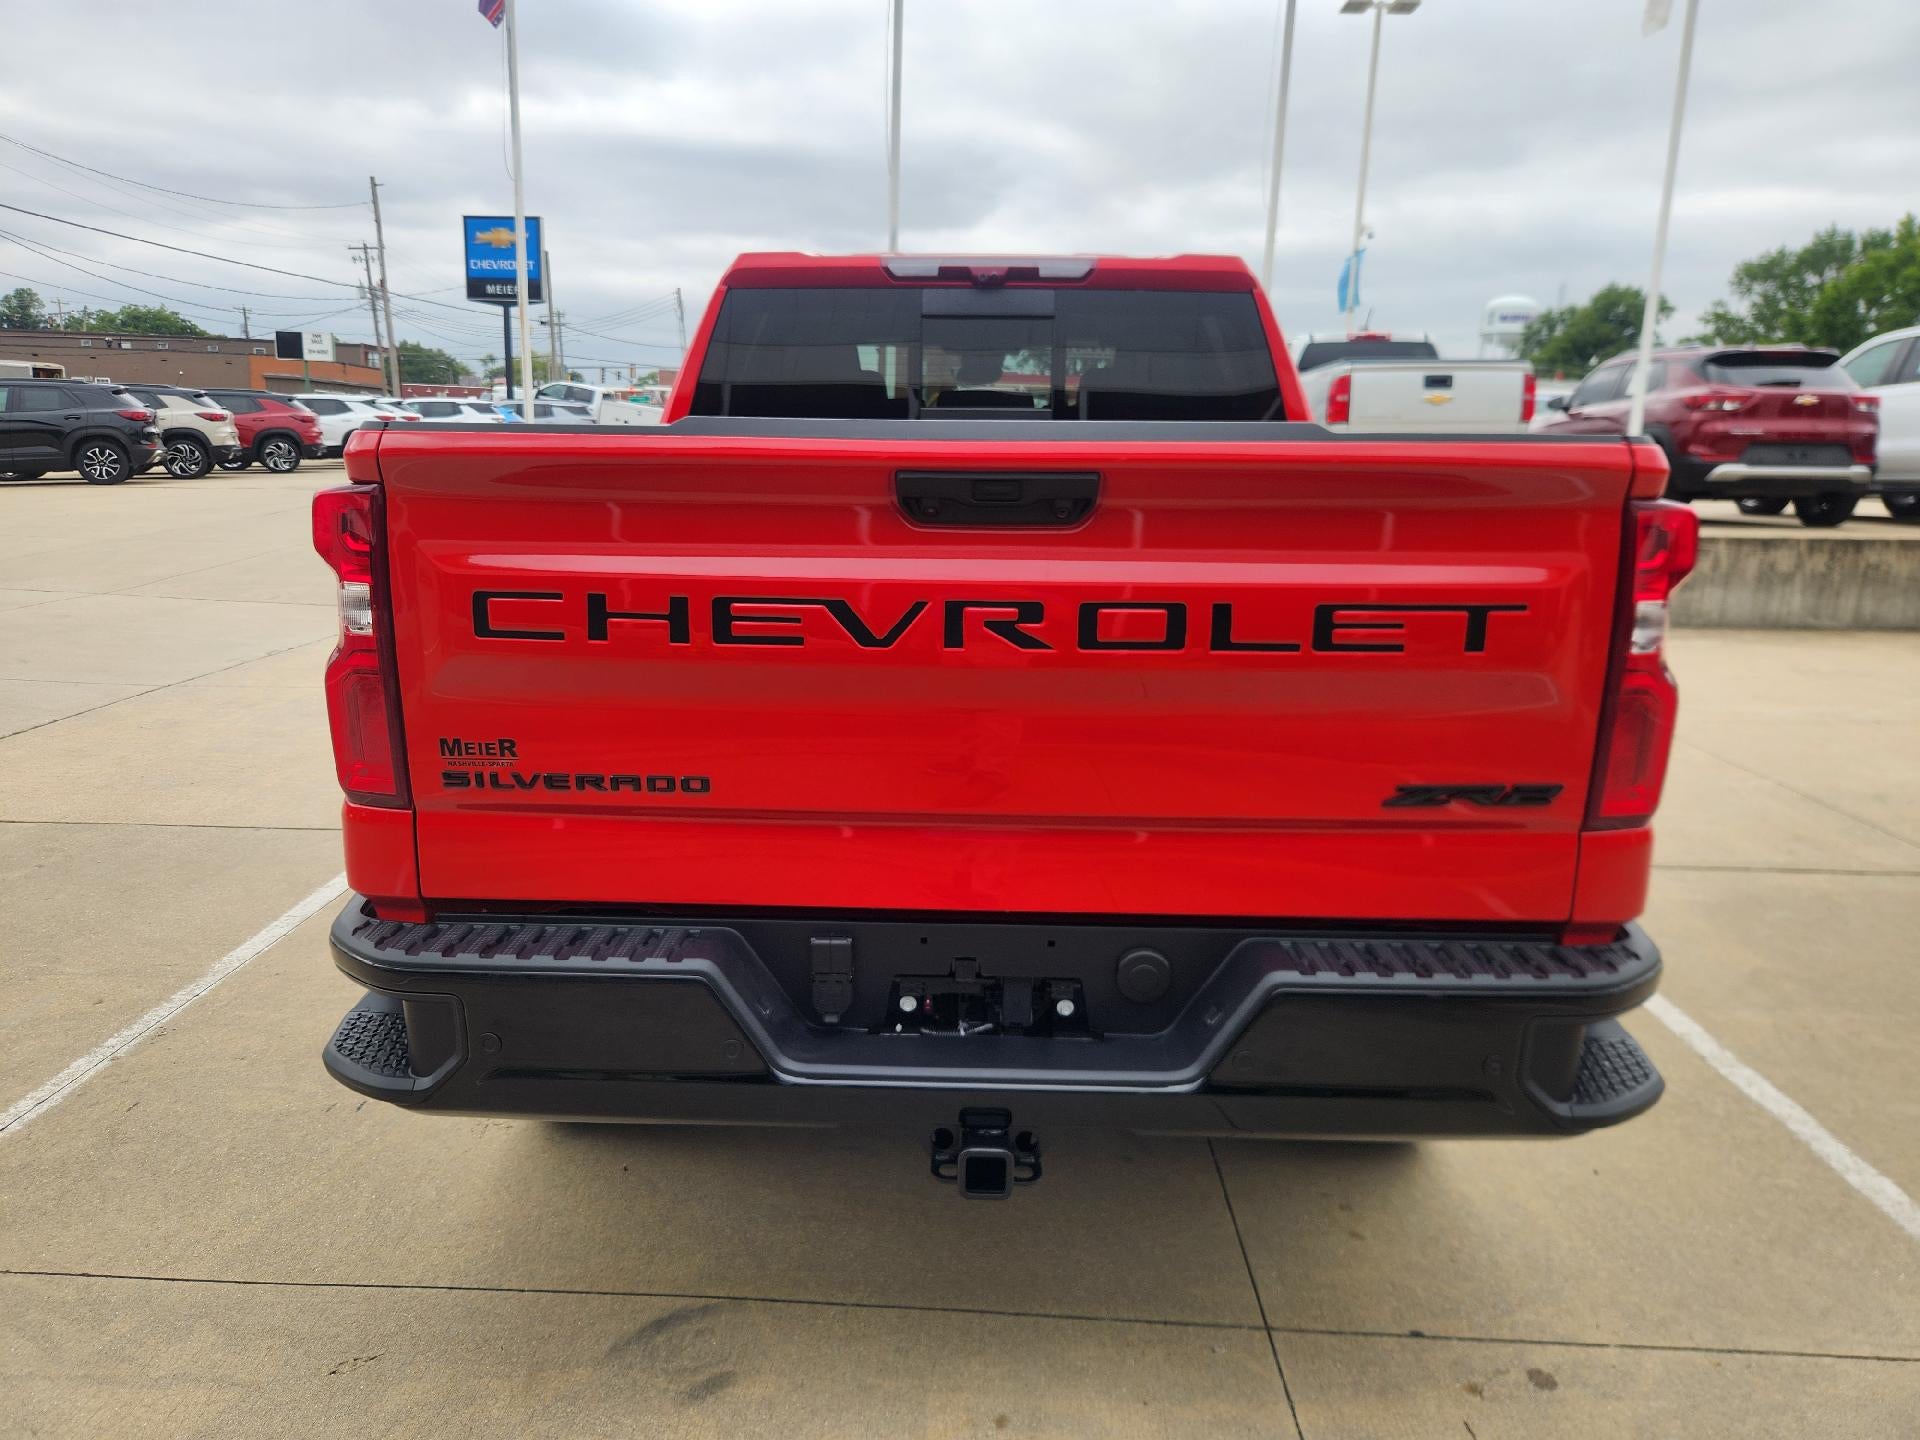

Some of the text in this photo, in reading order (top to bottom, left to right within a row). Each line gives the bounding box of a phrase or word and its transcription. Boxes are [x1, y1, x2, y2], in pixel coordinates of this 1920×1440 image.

[470, 259, 536, 271] CHEVROET
[472, 590, 1528, 654] CHEVROLET
[439, 737, 518, 757] MEIER
[441, 770, 711, 793] SILVERADO
[1381, 784, 1564, 807] ZR2
